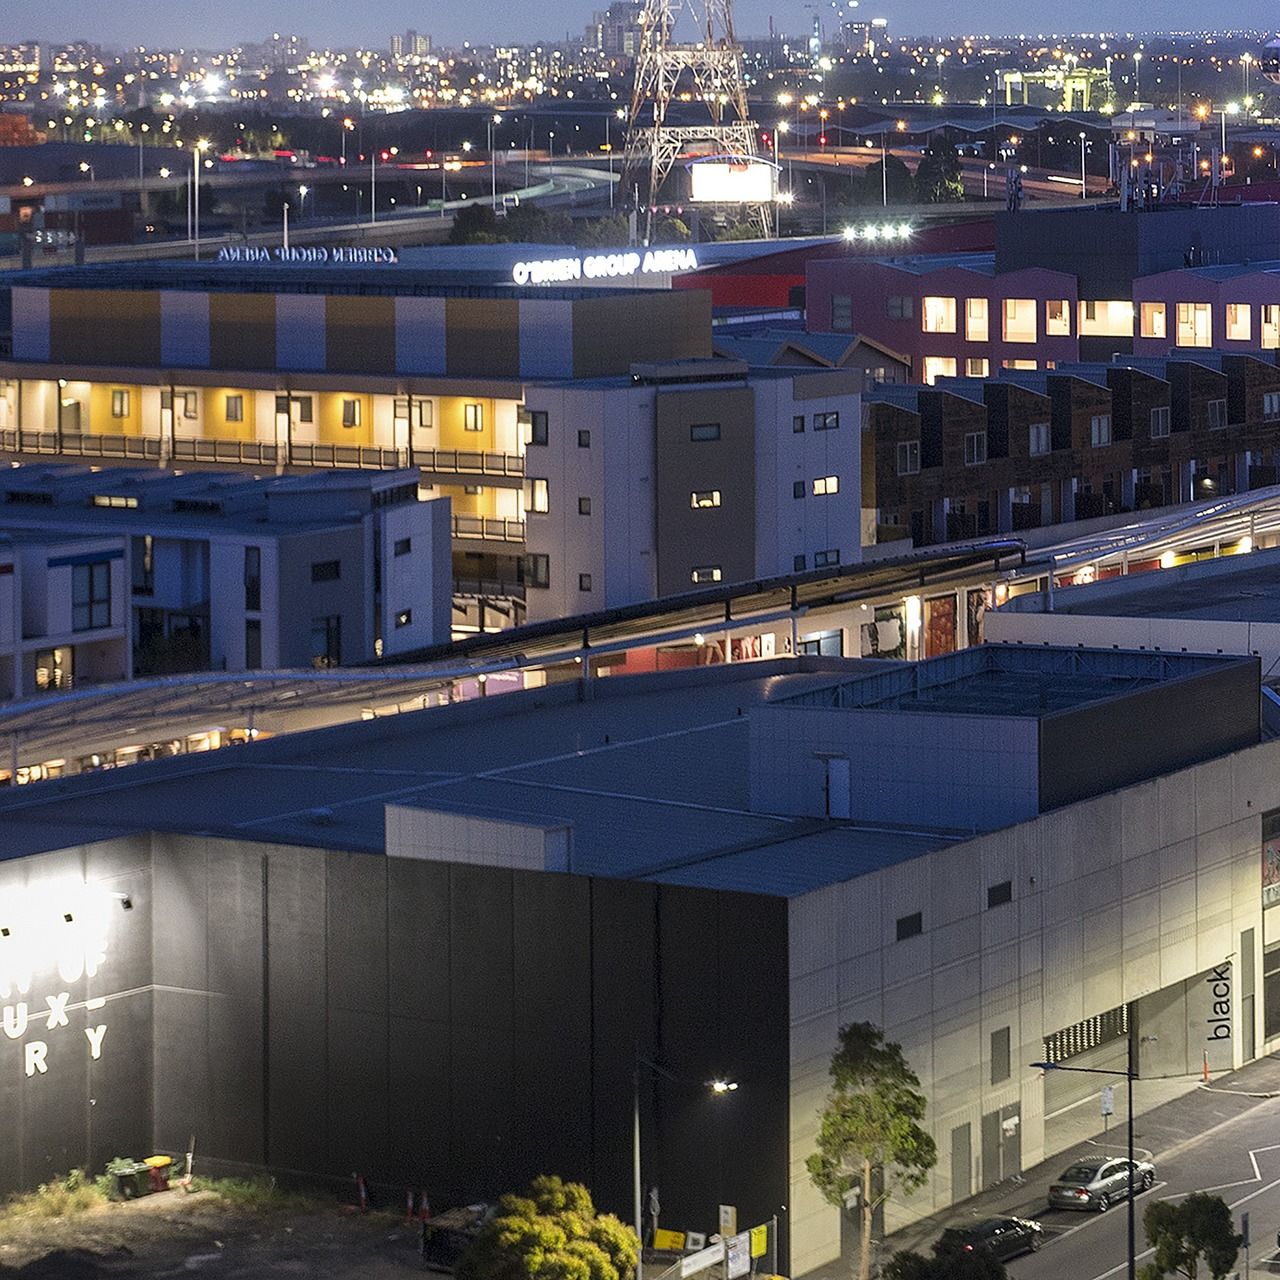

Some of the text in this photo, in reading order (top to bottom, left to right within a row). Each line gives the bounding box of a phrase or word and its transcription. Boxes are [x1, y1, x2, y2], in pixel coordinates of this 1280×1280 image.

[513, 248, 698, 285] O'BRIEN GROUP ARENA
[1206, 967, 1231, 1041] black
